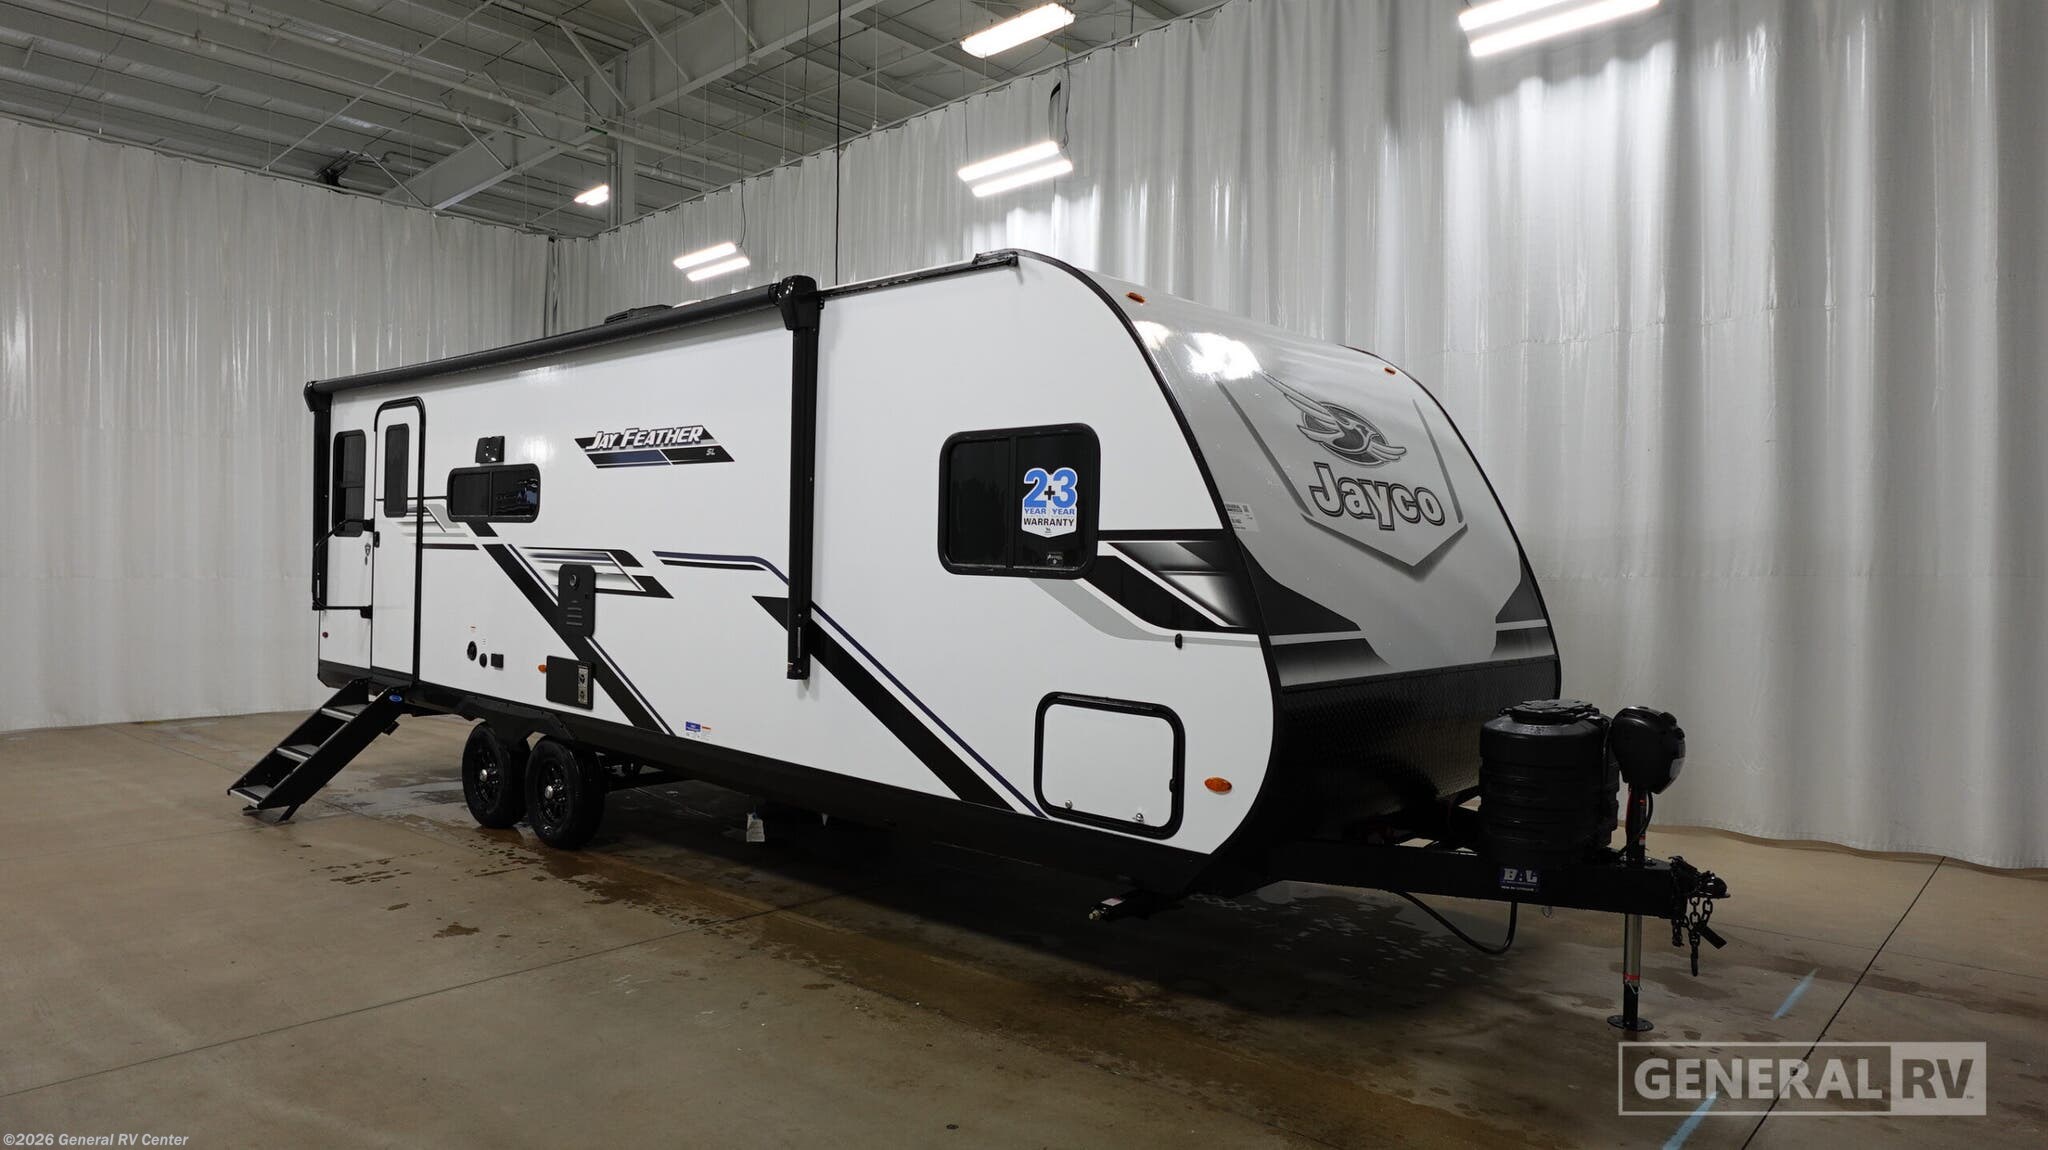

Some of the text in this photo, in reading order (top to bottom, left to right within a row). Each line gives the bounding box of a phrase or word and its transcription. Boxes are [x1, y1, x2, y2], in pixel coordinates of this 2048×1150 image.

[585, 426, 704, 451] JAY FEATHER
[1309, 461, 1446, 531] Jayco
[1052, 508, 1075, 516] YEAR
[1023, 518, 1075, 527] WARRANTY
